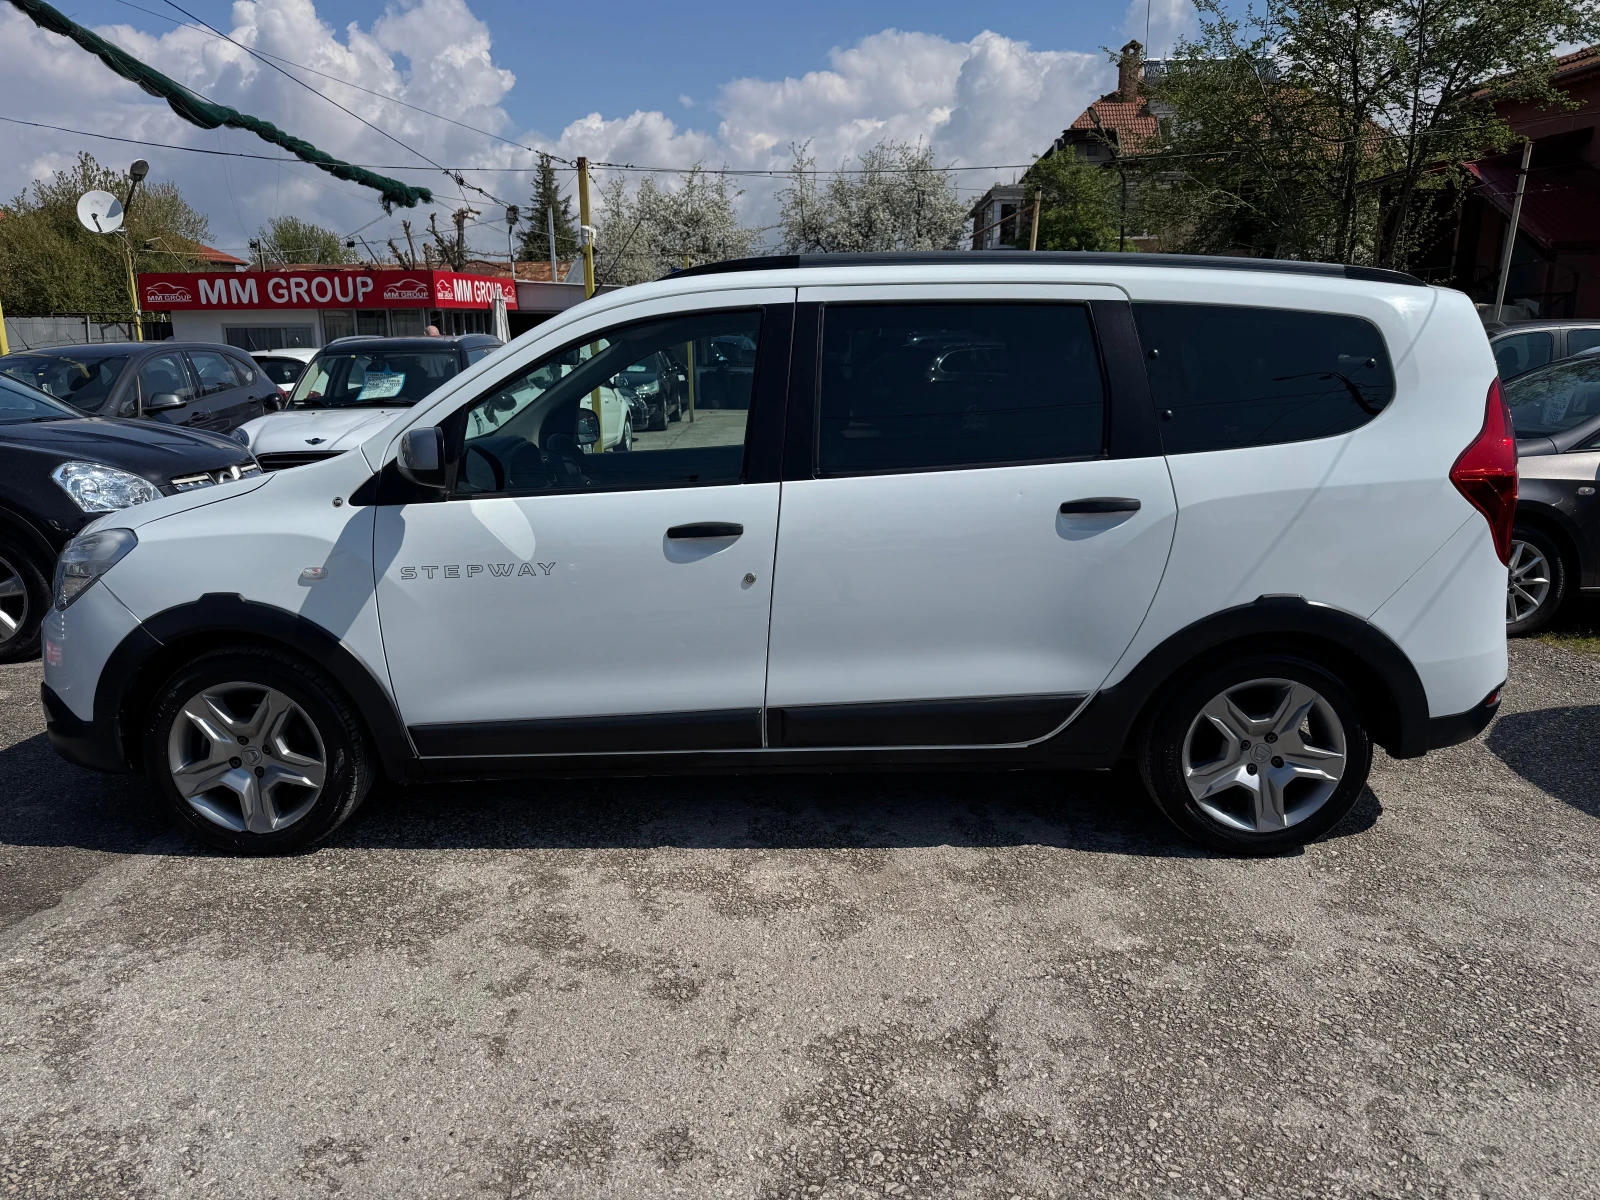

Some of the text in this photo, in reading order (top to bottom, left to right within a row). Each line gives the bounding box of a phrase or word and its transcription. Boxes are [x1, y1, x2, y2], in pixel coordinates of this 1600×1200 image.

[164, 293, 192, 301] GROUP
[198, 276, 373, 305] MM GROUP
[453, 278, 473, 303] MM
[400, 562, 557, 580] STEPWAY
